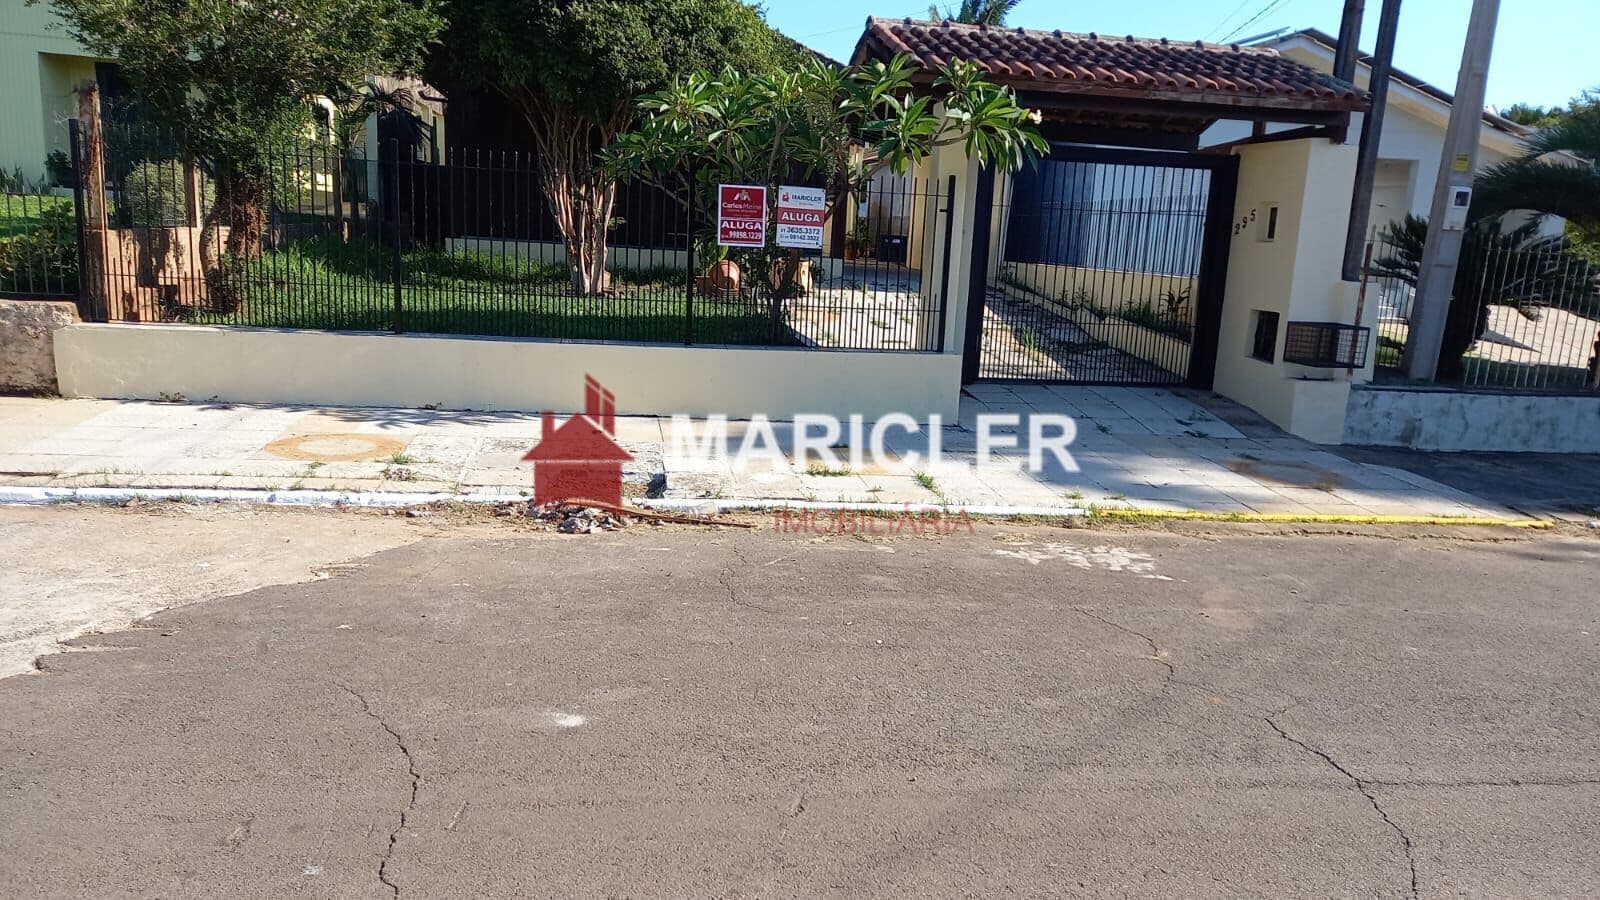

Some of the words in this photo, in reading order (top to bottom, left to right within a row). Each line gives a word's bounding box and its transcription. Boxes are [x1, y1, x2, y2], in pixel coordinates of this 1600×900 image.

[791, 194, 822, 202] MARICLER
[781, 211, 821, 223] ALUGA
[1234, 208, 1257, 236] 295
[721, 220, 762, 231] ALUGA
